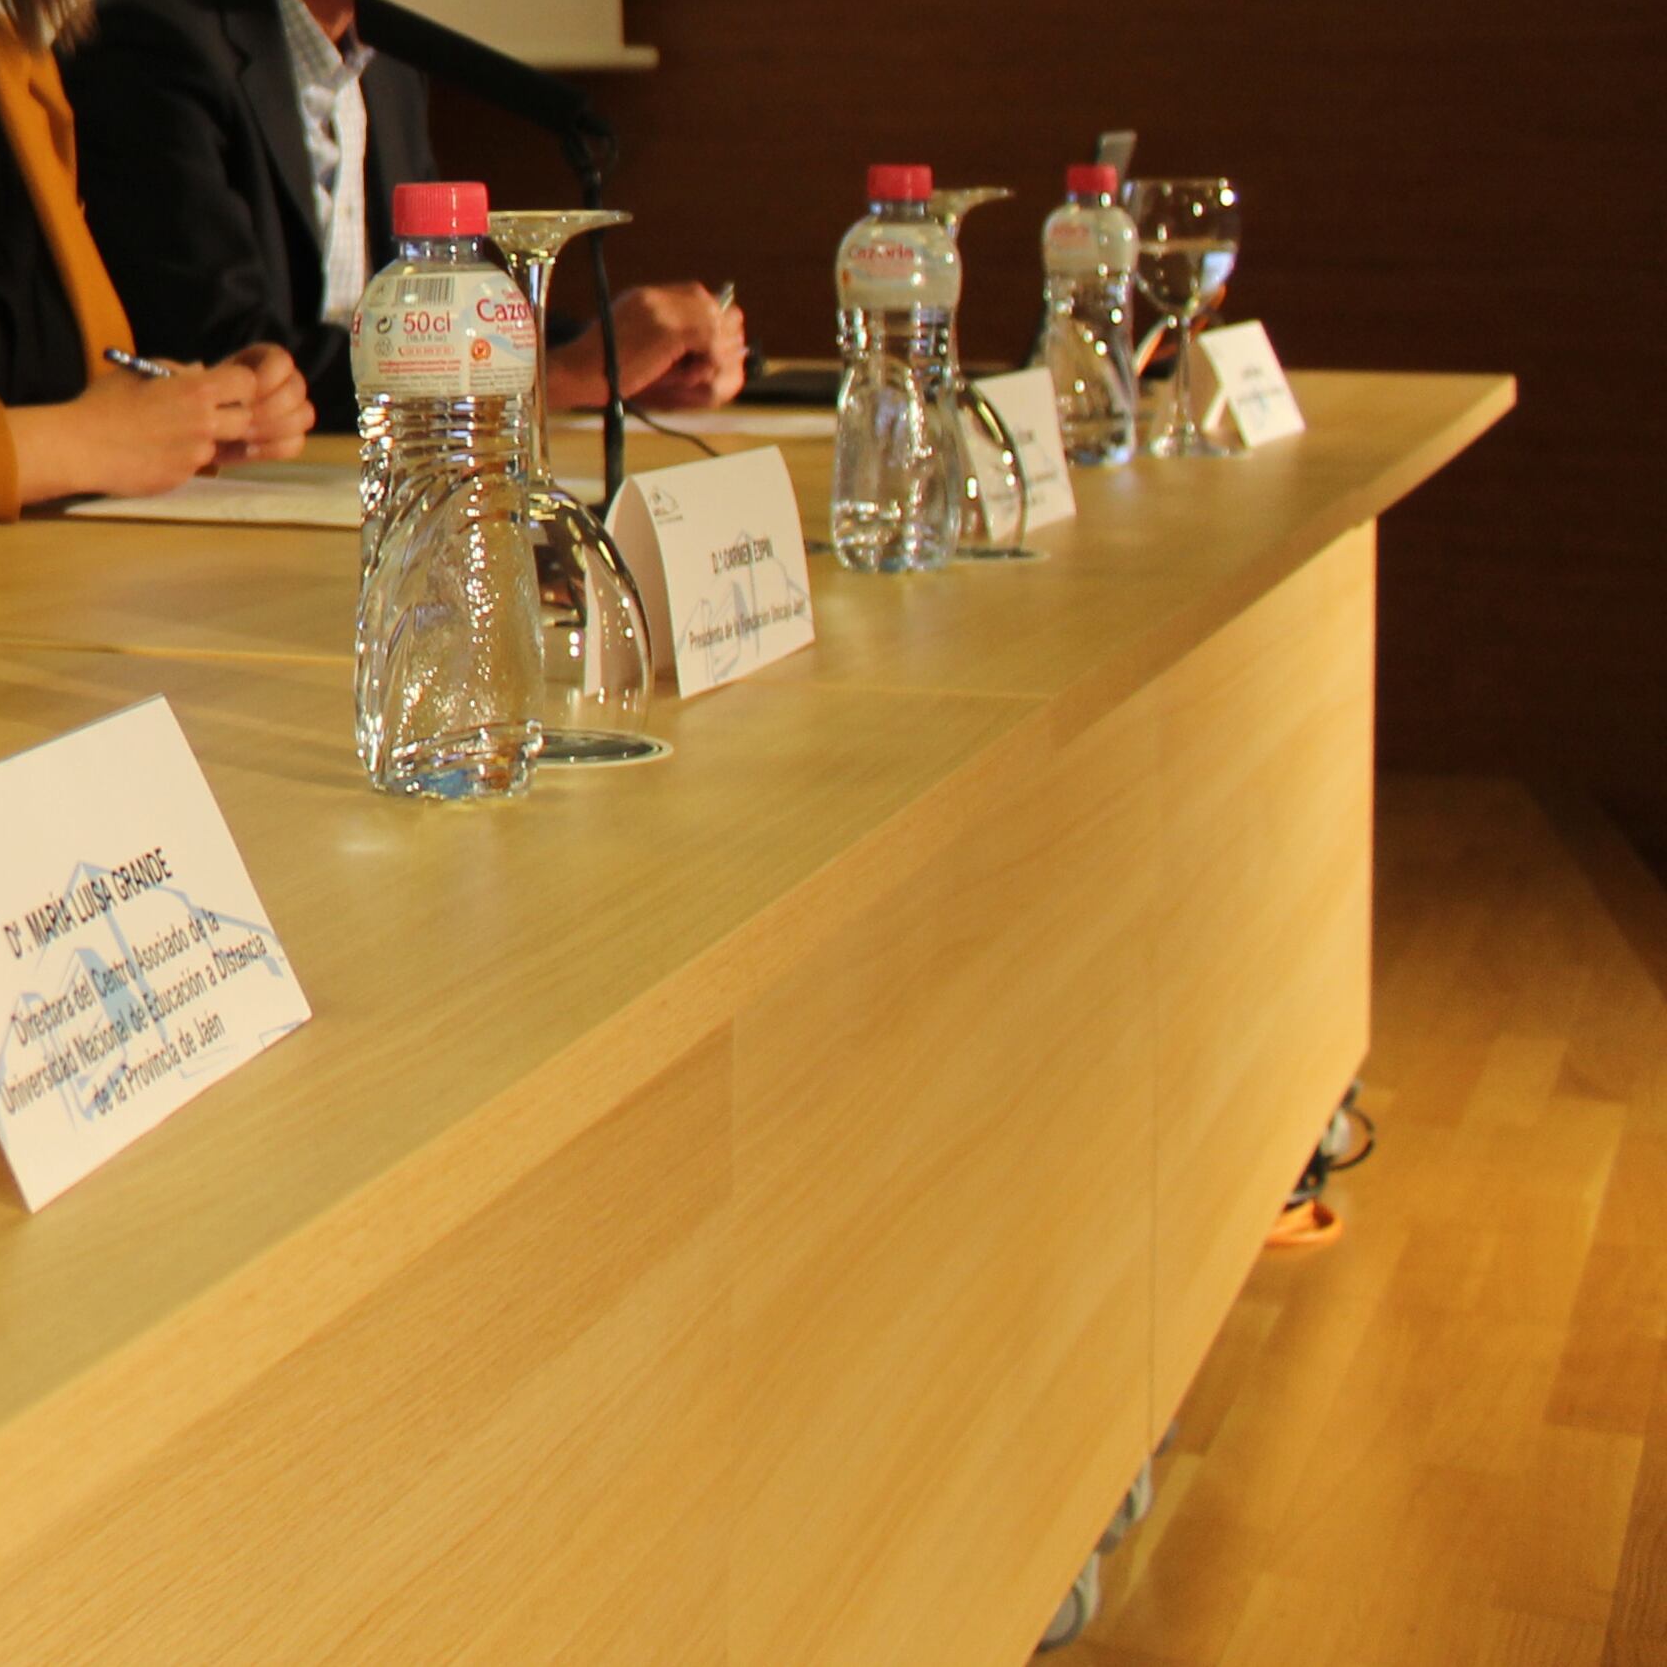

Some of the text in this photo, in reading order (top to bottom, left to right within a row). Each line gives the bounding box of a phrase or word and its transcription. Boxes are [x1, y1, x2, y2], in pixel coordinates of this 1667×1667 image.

[25, 890, 79, 948] MARÍA
[69, 877, 118, 924] LUISA
[111, 846, 173, 902] GRANDE
[0, 929, 269, 1117] Universidad Nacional de Educación a Distancia
[10, 907, 221, 1047] Directora del Centro Asociado de la
[92, 1009, 227, 1116] de la Provincia de Jaén
